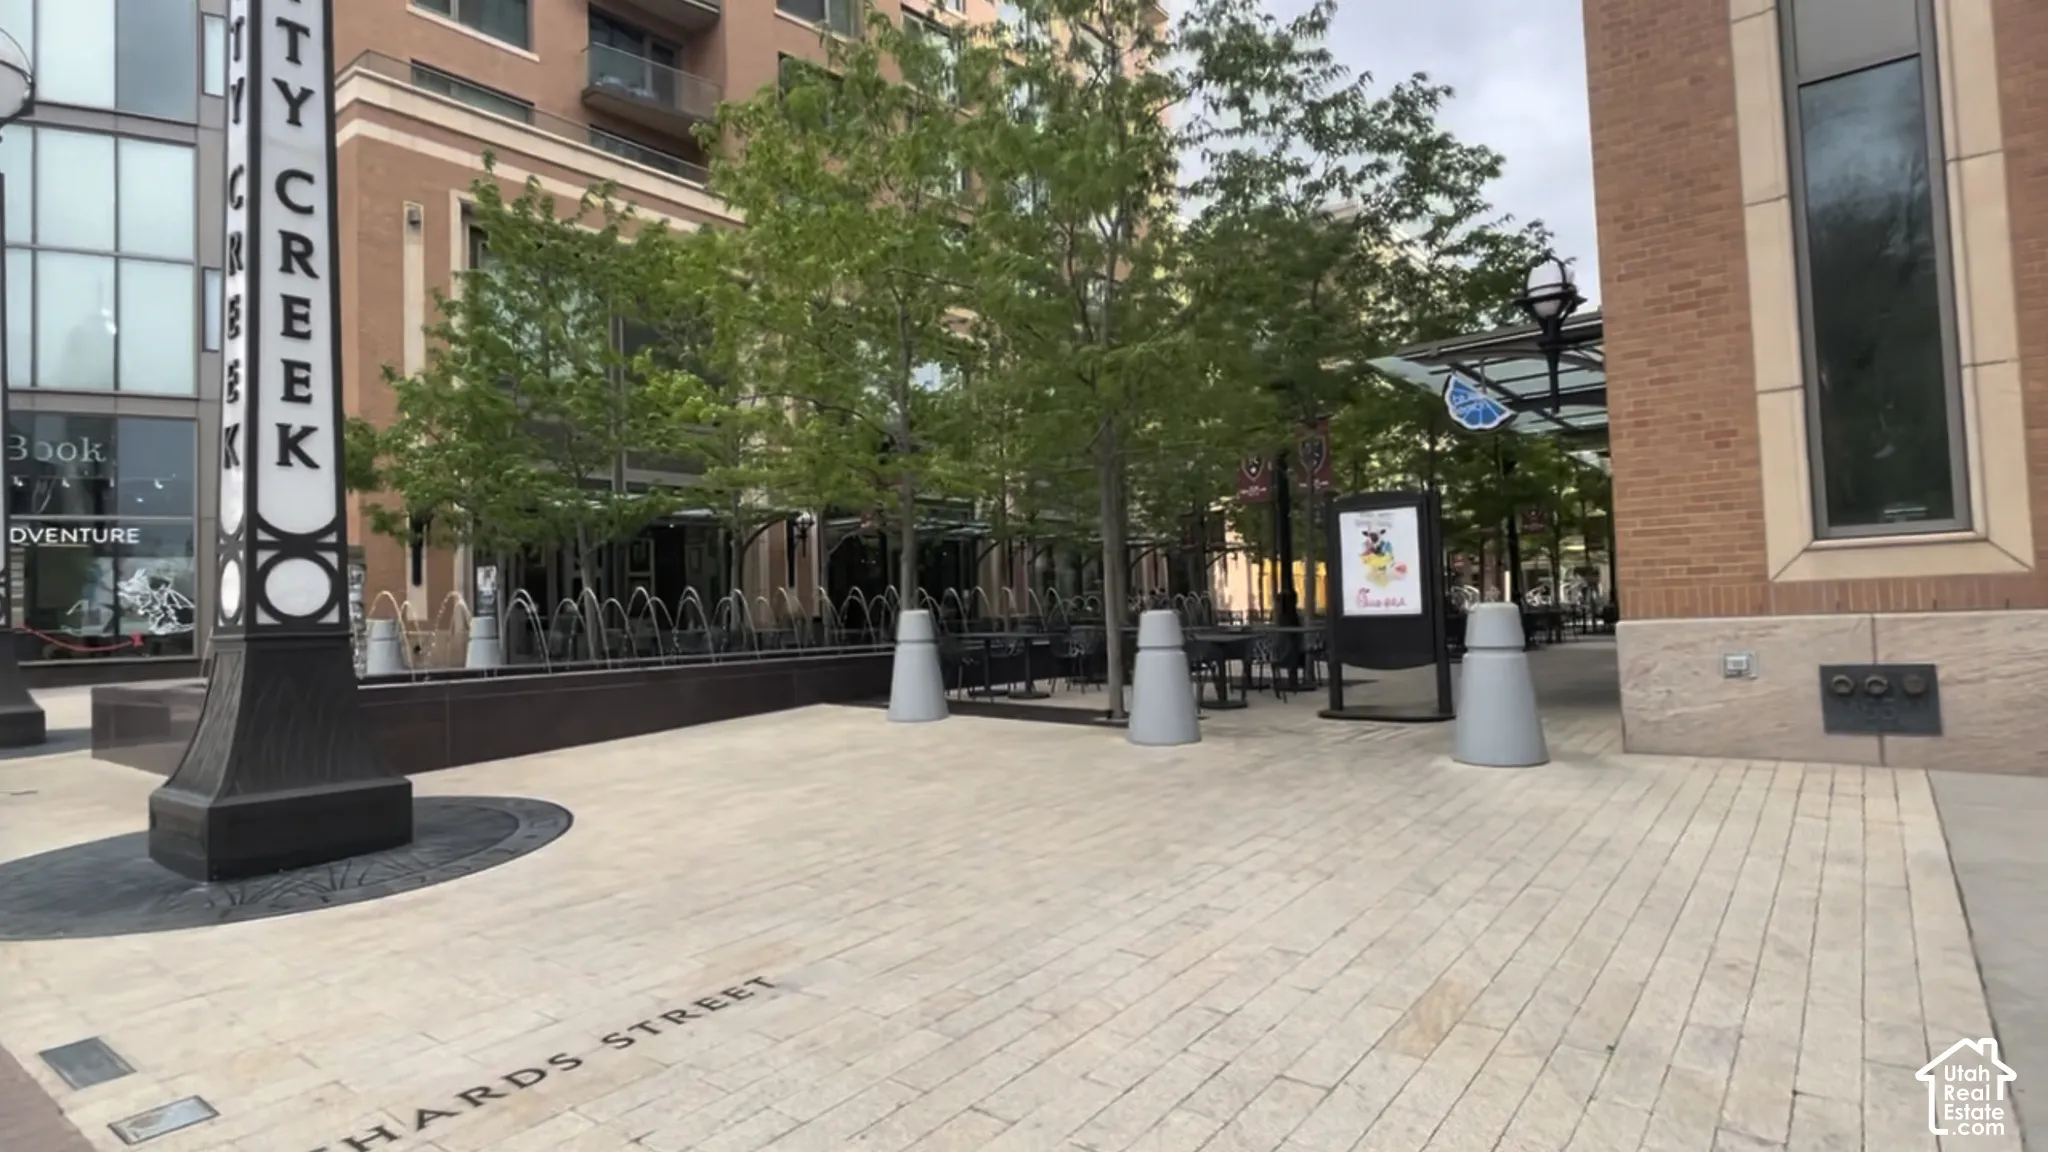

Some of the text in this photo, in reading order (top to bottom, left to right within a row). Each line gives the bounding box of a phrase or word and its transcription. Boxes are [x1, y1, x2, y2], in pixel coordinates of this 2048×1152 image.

[229, 0, 245, 125] TY
[272, 0, 320, 470] TY CREEK
[9, 527, 140, 544] DVENTURE
[309, 976, 775, 1152] HARDS STREET
